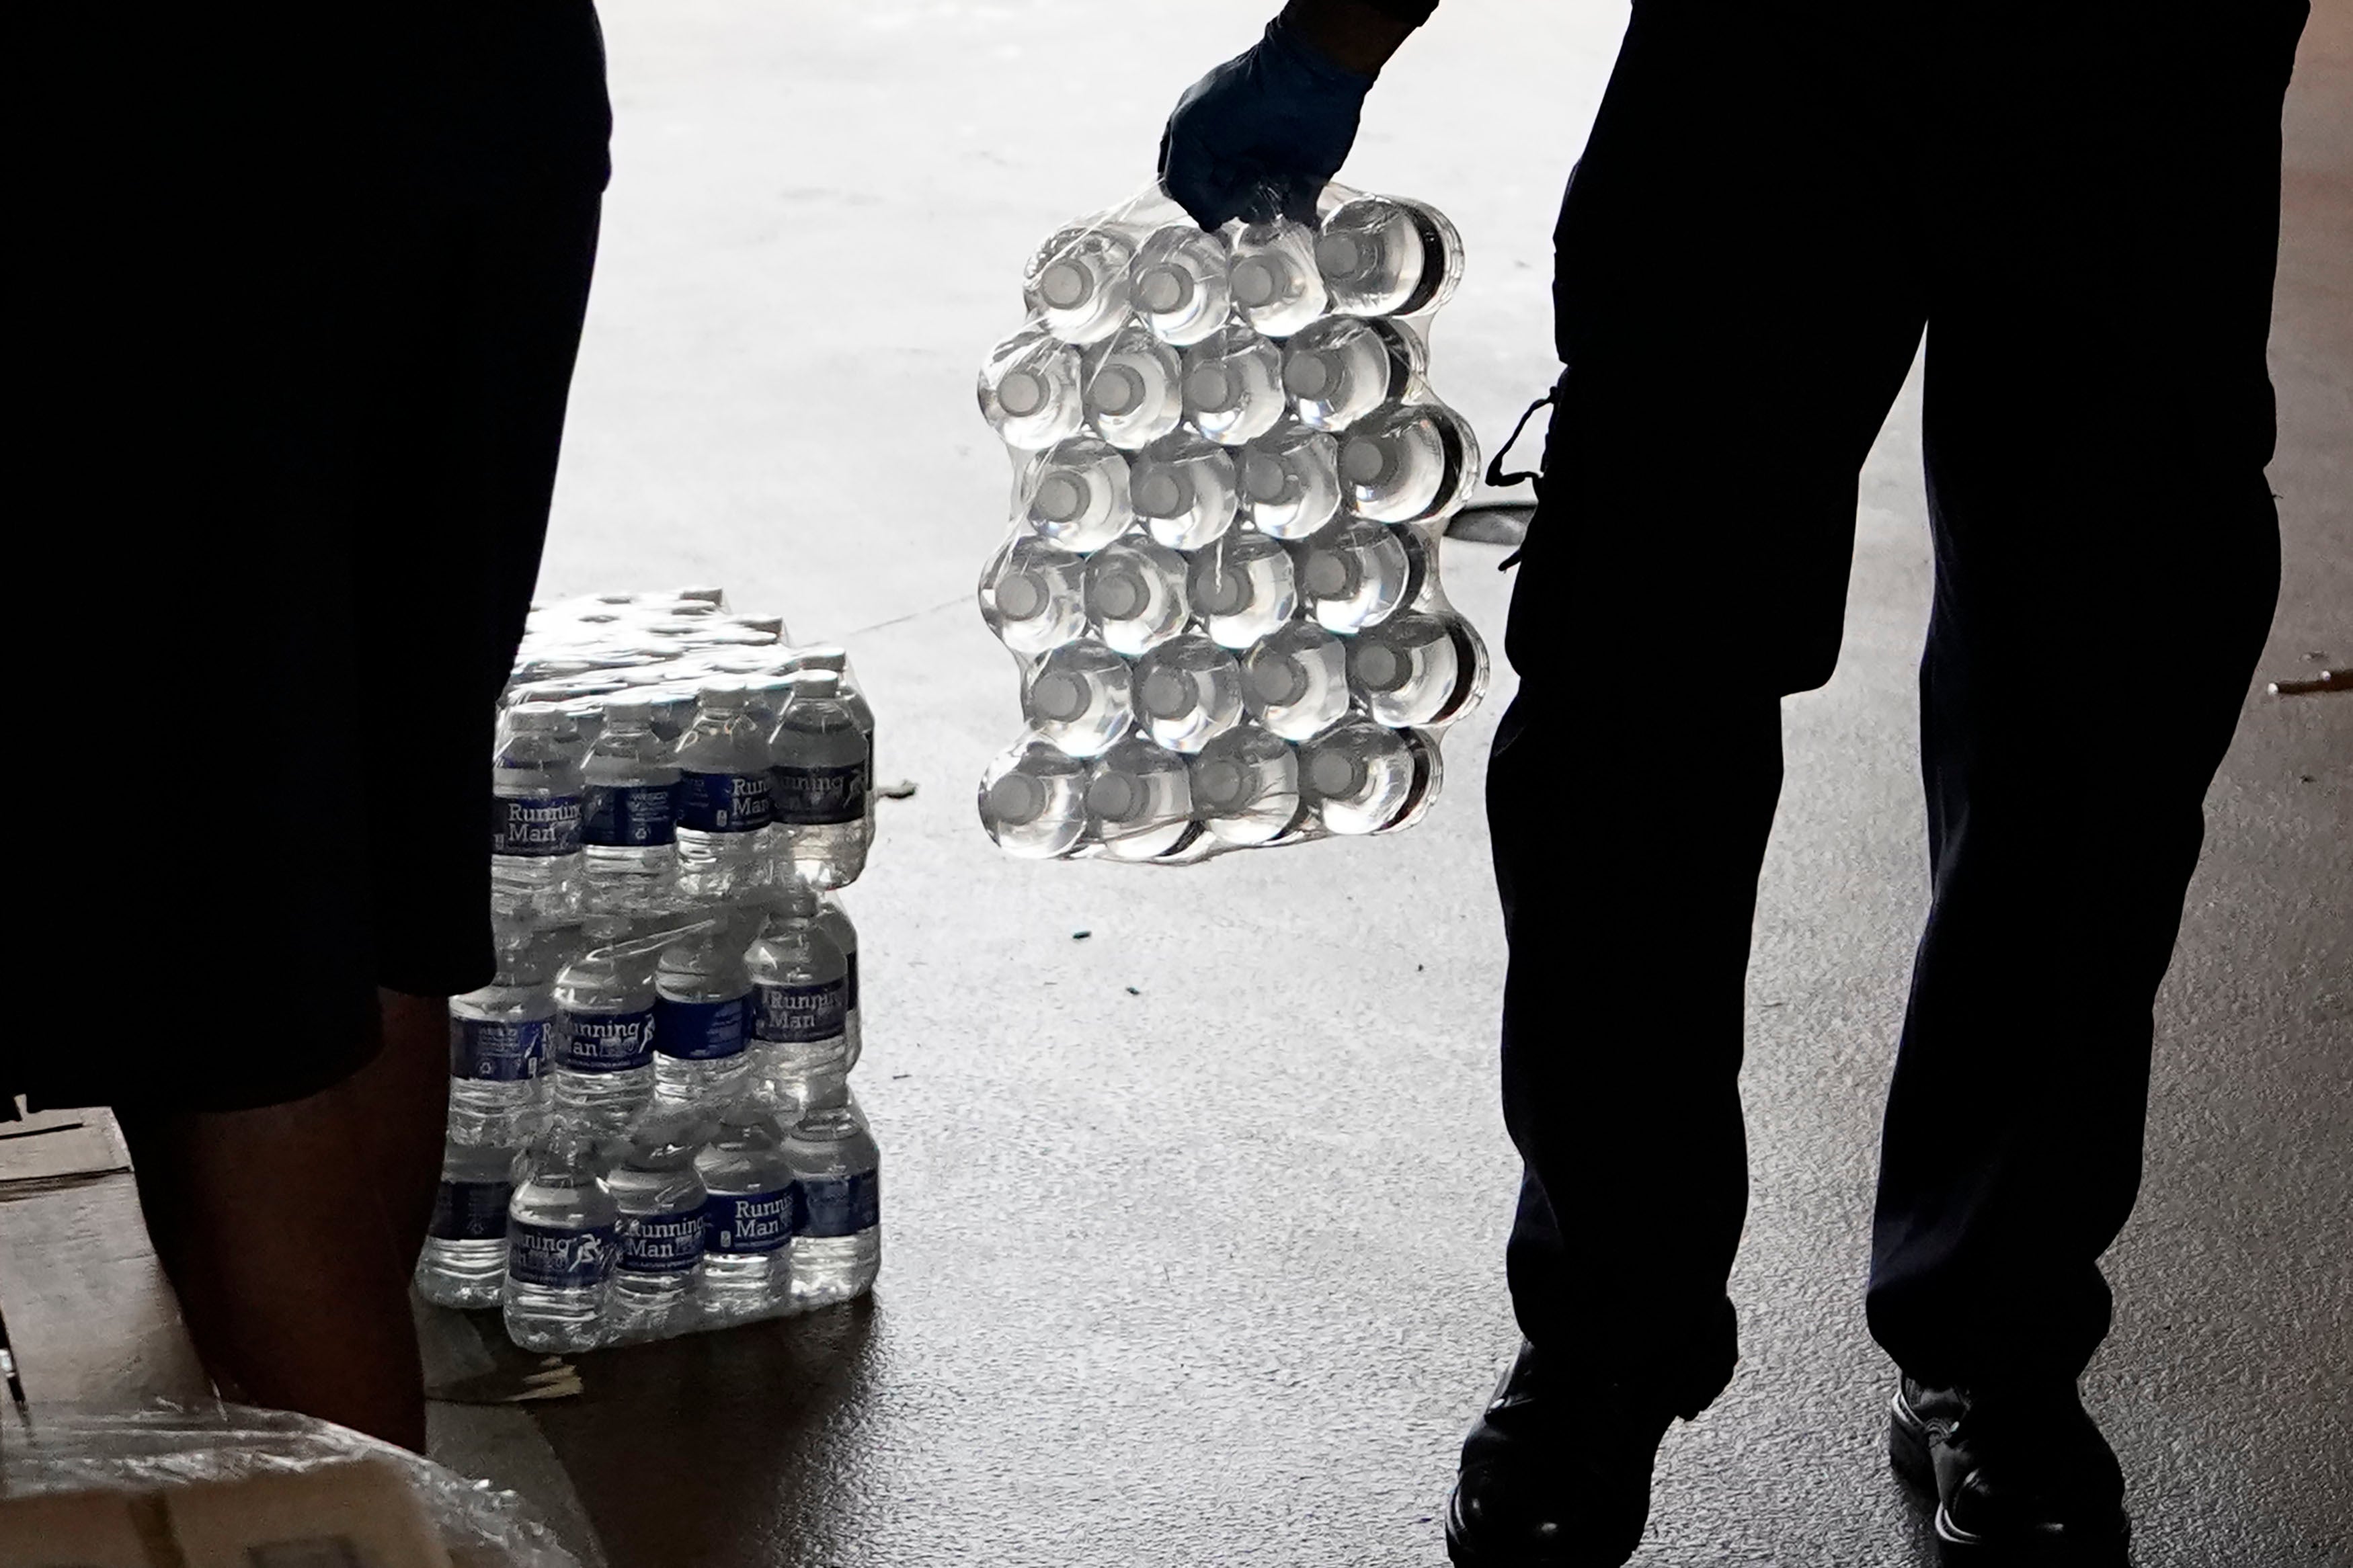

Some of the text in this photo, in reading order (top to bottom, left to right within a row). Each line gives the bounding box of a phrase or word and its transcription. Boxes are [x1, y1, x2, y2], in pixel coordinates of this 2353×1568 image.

[508, 823, 557, 842] Man
[768, 1010, 815, 1029] Man
[572, 1041, 598, 1057] an
[735, 1219, 779, 1238] Man
[626, 1238, 675, 1258] Man
